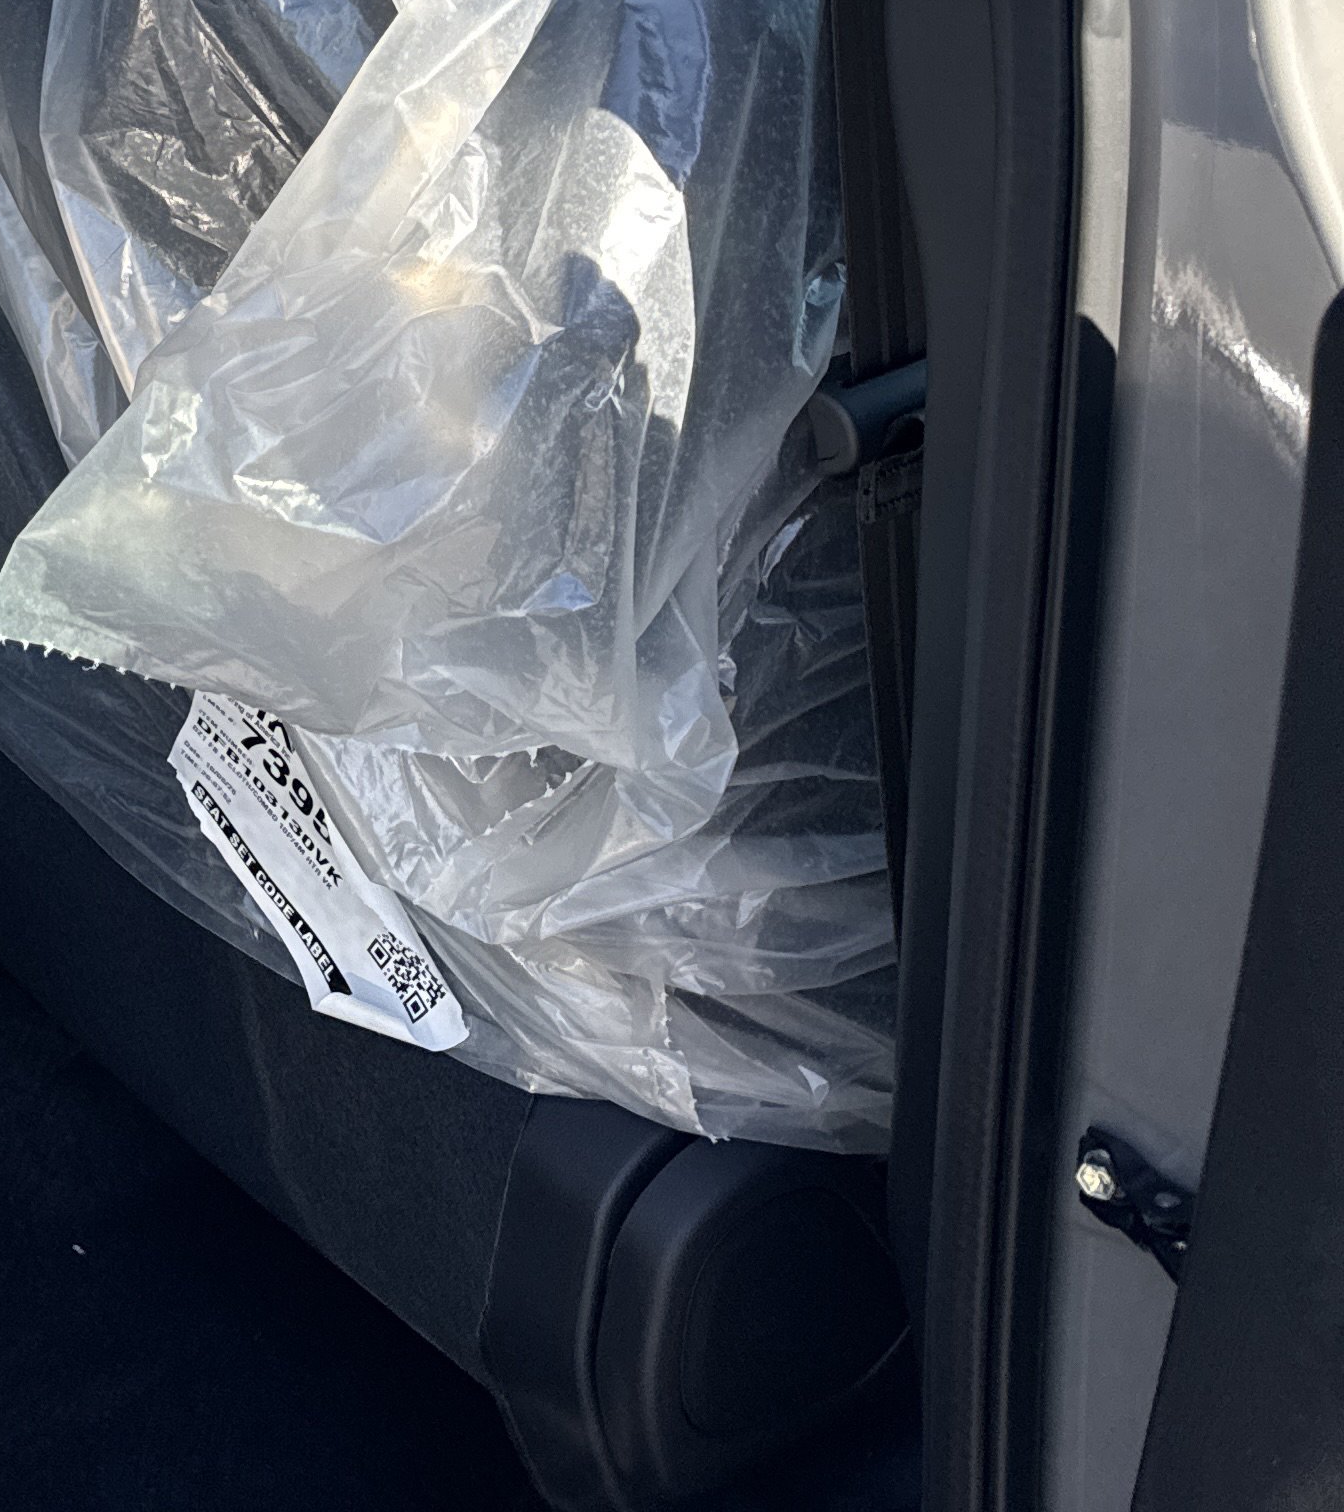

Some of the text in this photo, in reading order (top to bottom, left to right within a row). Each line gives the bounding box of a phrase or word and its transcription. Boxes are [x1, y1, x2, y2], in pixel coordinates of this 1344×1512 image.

[246, 712, 254, 721] of
[255, 720, 281, 748] America
[197, 717, 343, 887] DFB103130VK
[194, 785, 229, 830] SEAT
[229, 832, 256, 869] SET
[255, 870, 294, 921] CODE
[295, 920, 334, 982] LABEL
[323, 877, 332, 889] VK
